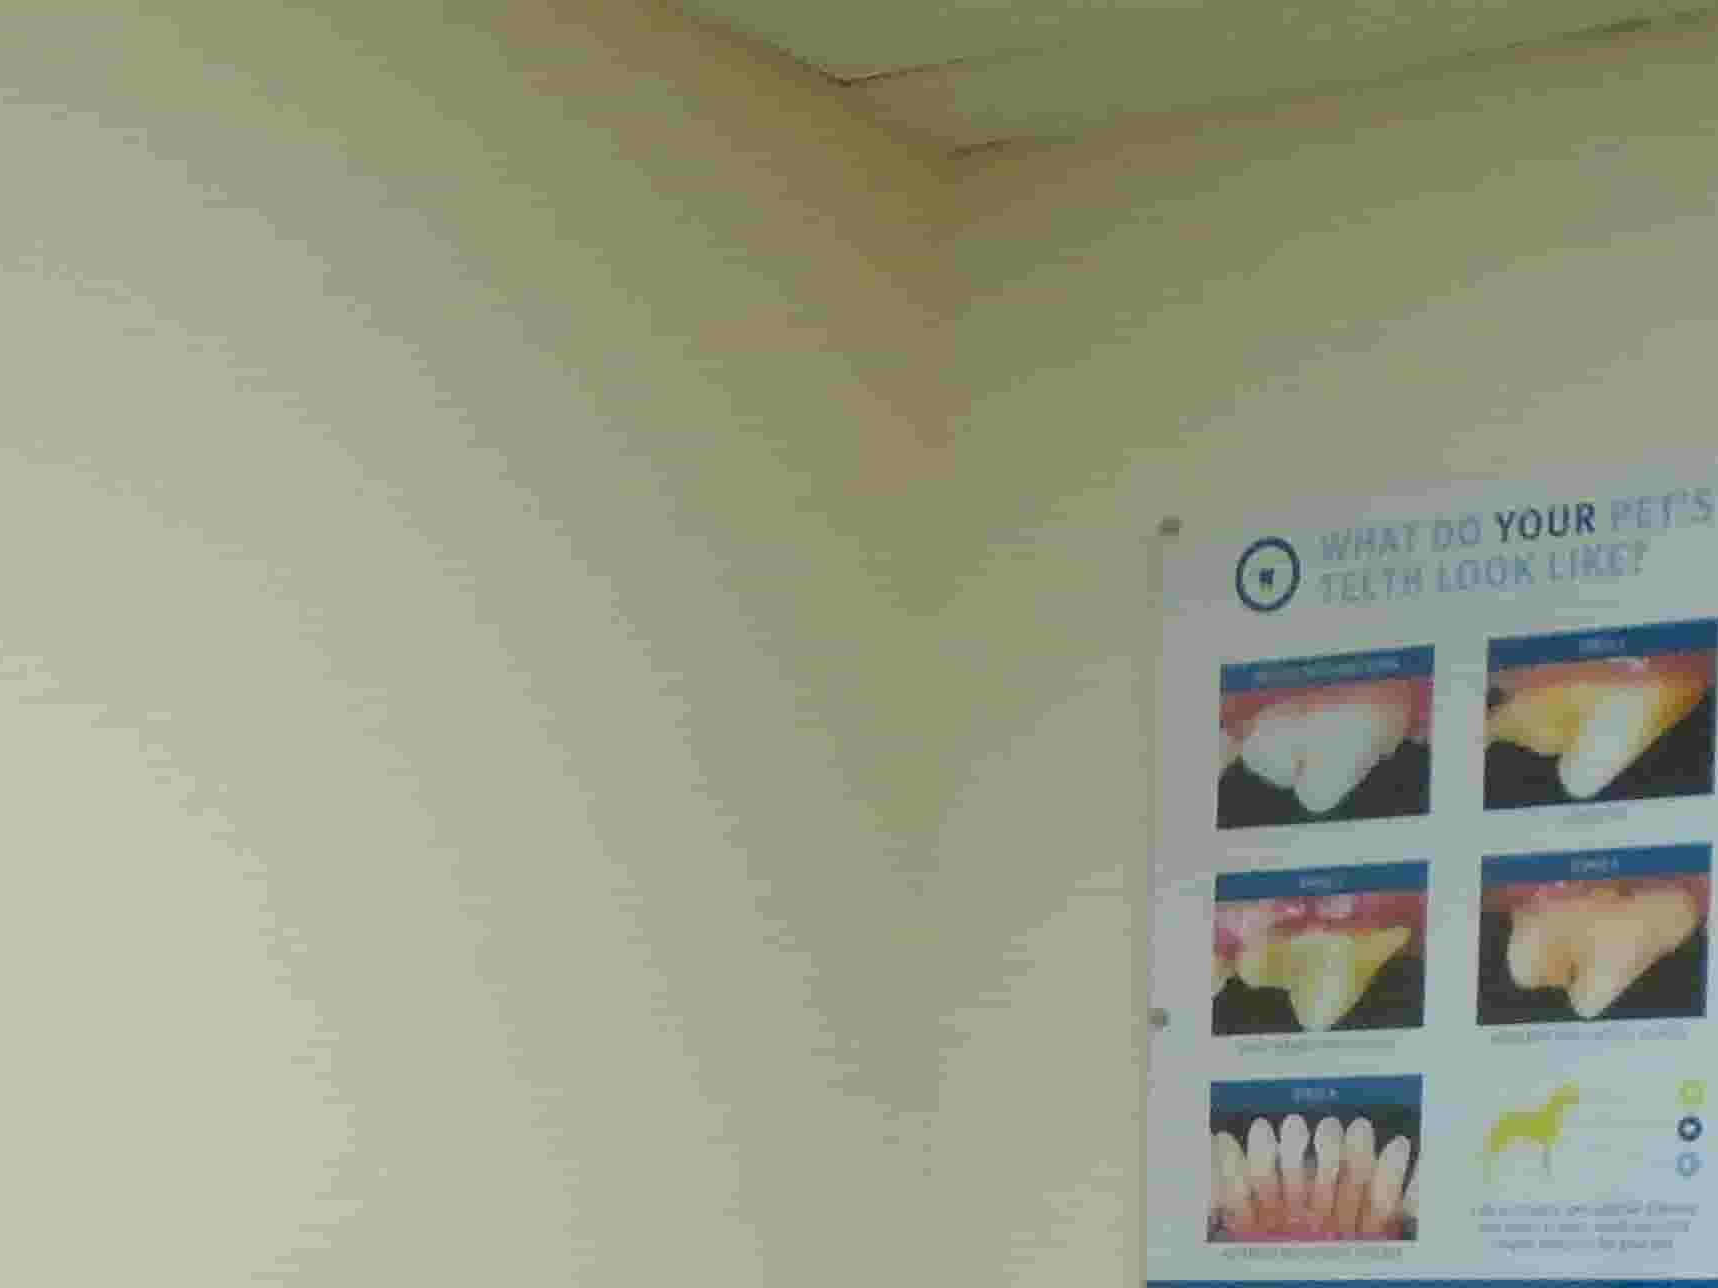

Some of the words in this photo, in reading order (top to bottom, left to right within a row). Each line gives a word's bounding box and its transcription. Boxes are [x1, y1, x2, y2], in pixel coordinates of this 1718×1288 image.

[1320, 521, 1418, 560] WHAT
[1433, 515, 1481, 552] DO
[1494, 502, 1595, 543] YOUR
[1611, 488, 1713, 530] PET'S
[1318, 567, 1421, 603] TEETH
[1436, 552, 1533, 593] LOOK
